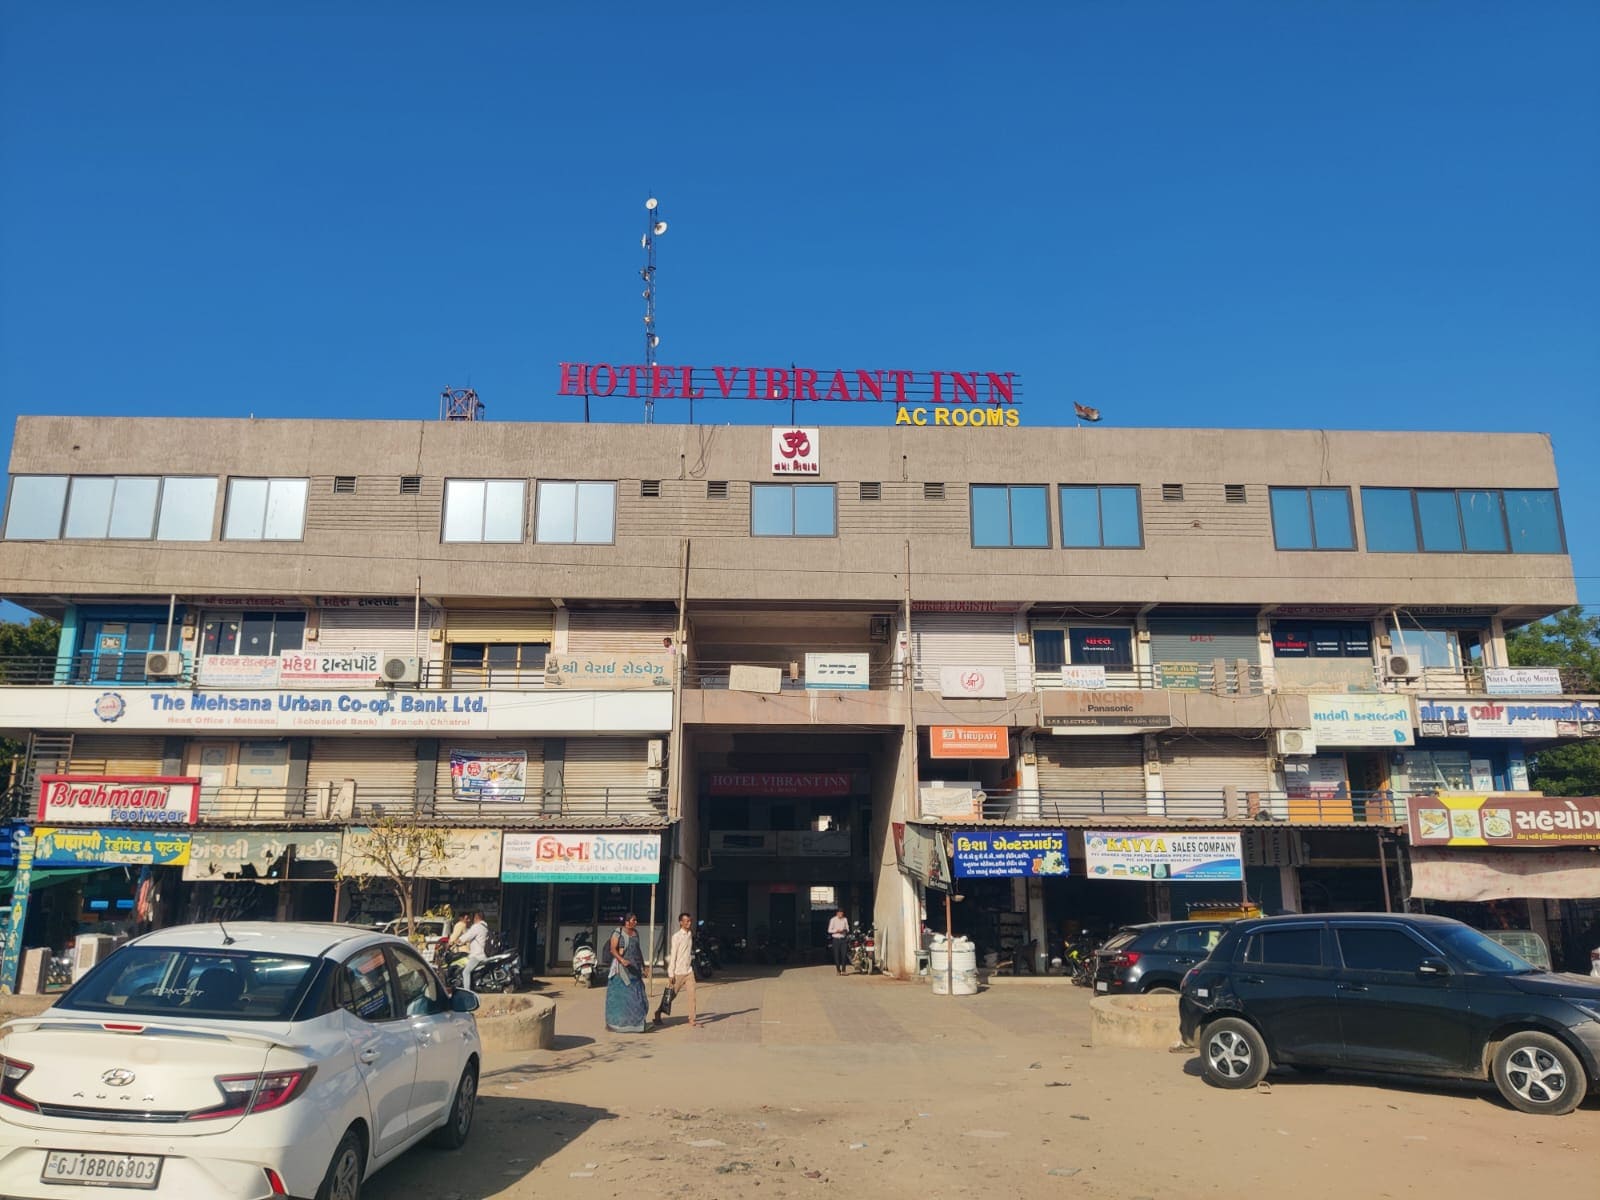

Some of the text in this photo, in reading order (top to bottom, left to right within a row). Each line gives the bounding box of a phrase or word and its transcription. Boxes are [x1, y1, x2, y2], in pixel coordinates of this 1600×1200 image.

[557, 362, 1015, 404] HOTEL VIBRANT INN
[896, 407, 1020, 427] AC ROOMS
[911, 600, 997, 611] SHREE LOGISTIC
[282, 655, 317, 671] મહેશ
[562, 661, 578, 673] શ્રી
[151, 694, 488, 716] The Mehsana Urban Co-op. Bank Ltd.
[1088, 704, 1134, 713] Panasonic
[1420, 701, 1455, 721] aira
[1458, 706, 1468, 720] &
[1470, 701, 1505, 721] cair
[351, 718, 378, 726] Bank)
[712, 775, 848, 787] HOTEL VIBRANT INN
[51, 782, 170, 808] Brahmani
[111, 809, 187, 823] Footwear
[143, 840, 152, 852] &
[1106, 837, 1236, 853] KAVYA SALES COMPANY
[152, 986, 204, 997] CONCEPT
[73, 1090, 154, 1102] AURA
